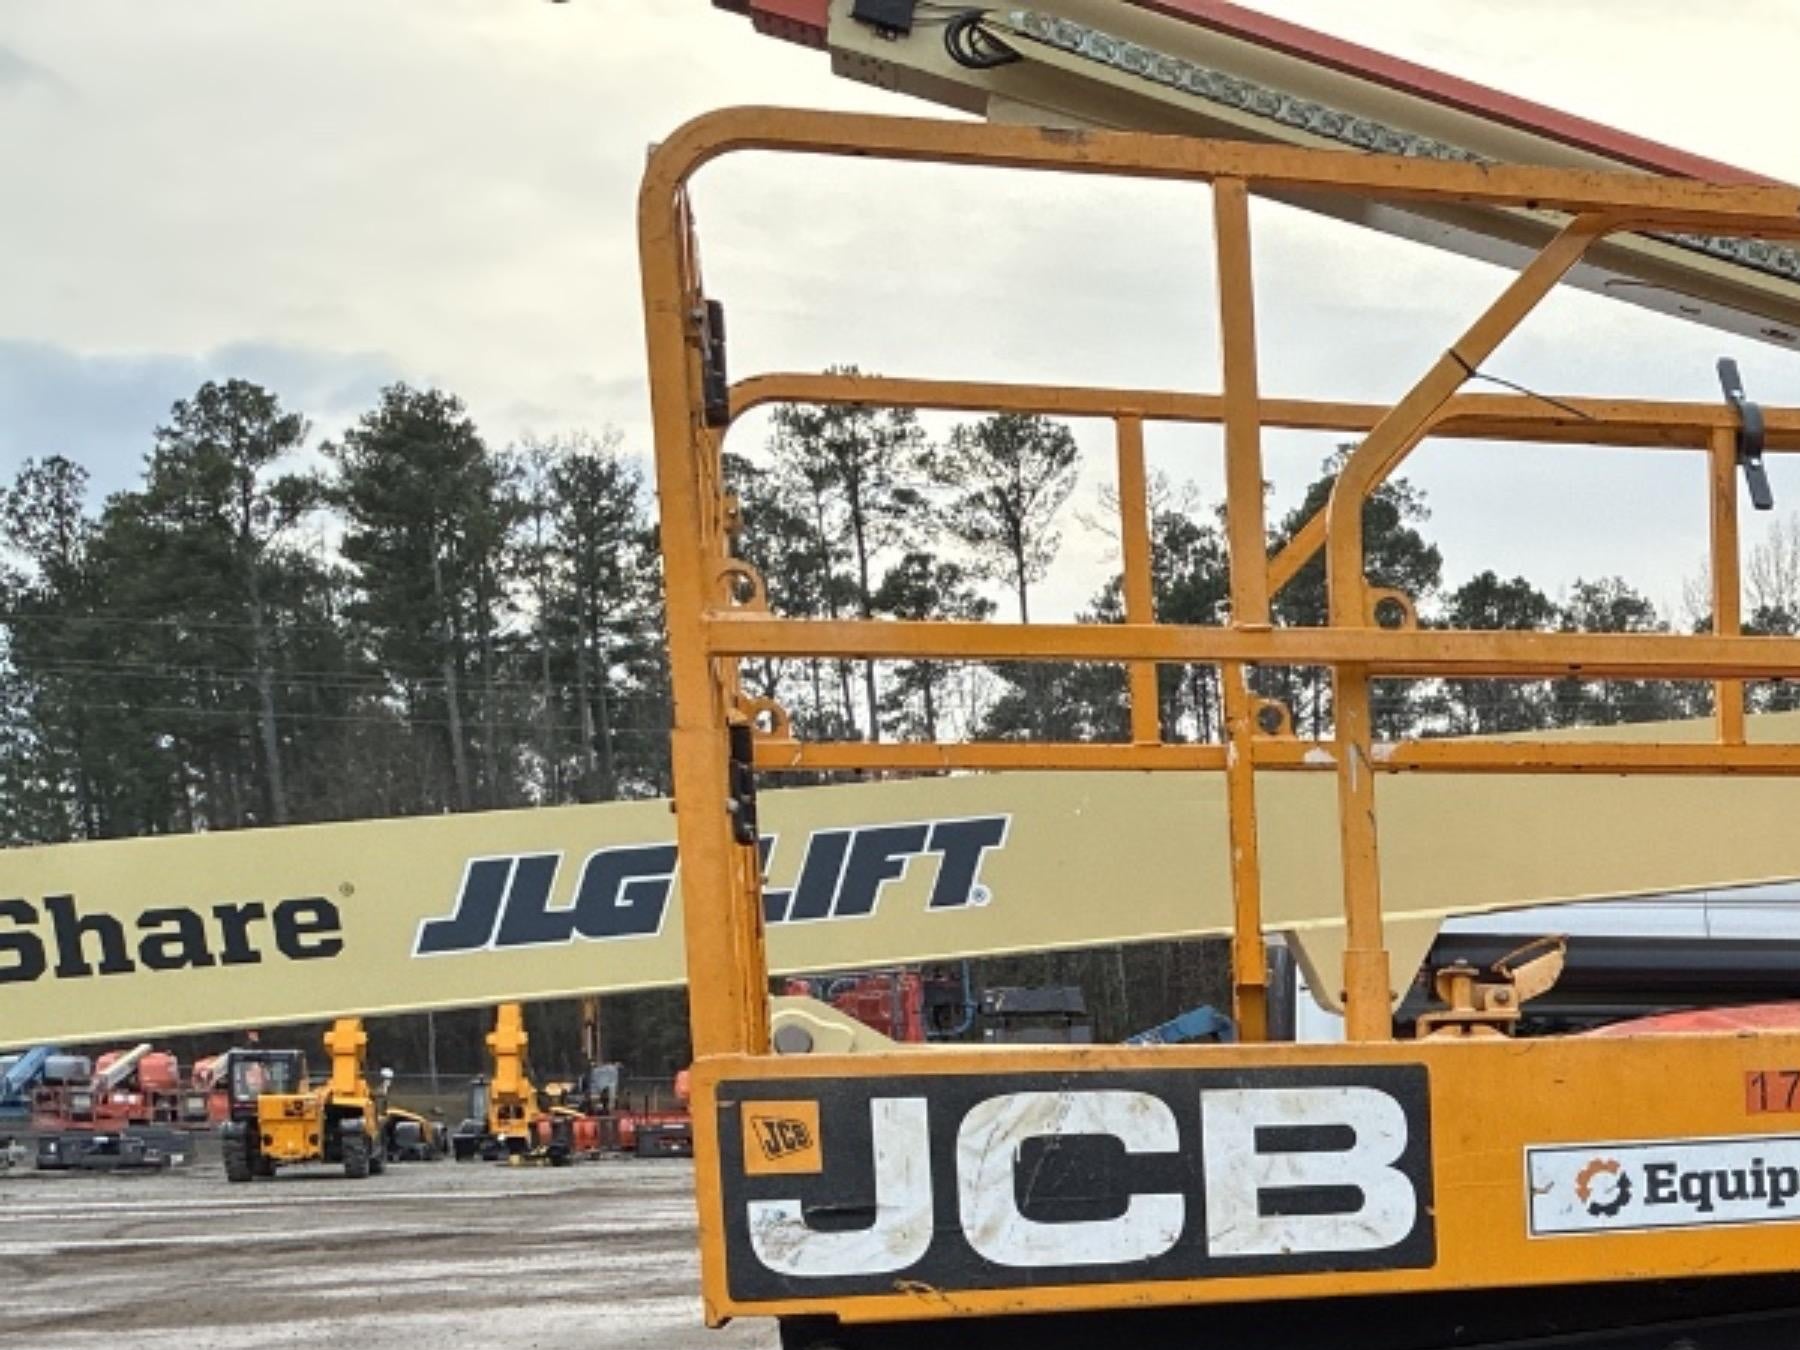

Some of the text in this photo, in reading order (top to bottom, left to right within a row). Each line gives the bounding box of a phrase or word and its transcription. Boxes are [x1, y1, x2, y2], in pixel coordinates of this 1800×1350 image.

[412, 845, 678, 955] JLG
[748, 1087, 1417, 1276] JCB
[763, 1117, 810, 1156] JCB
